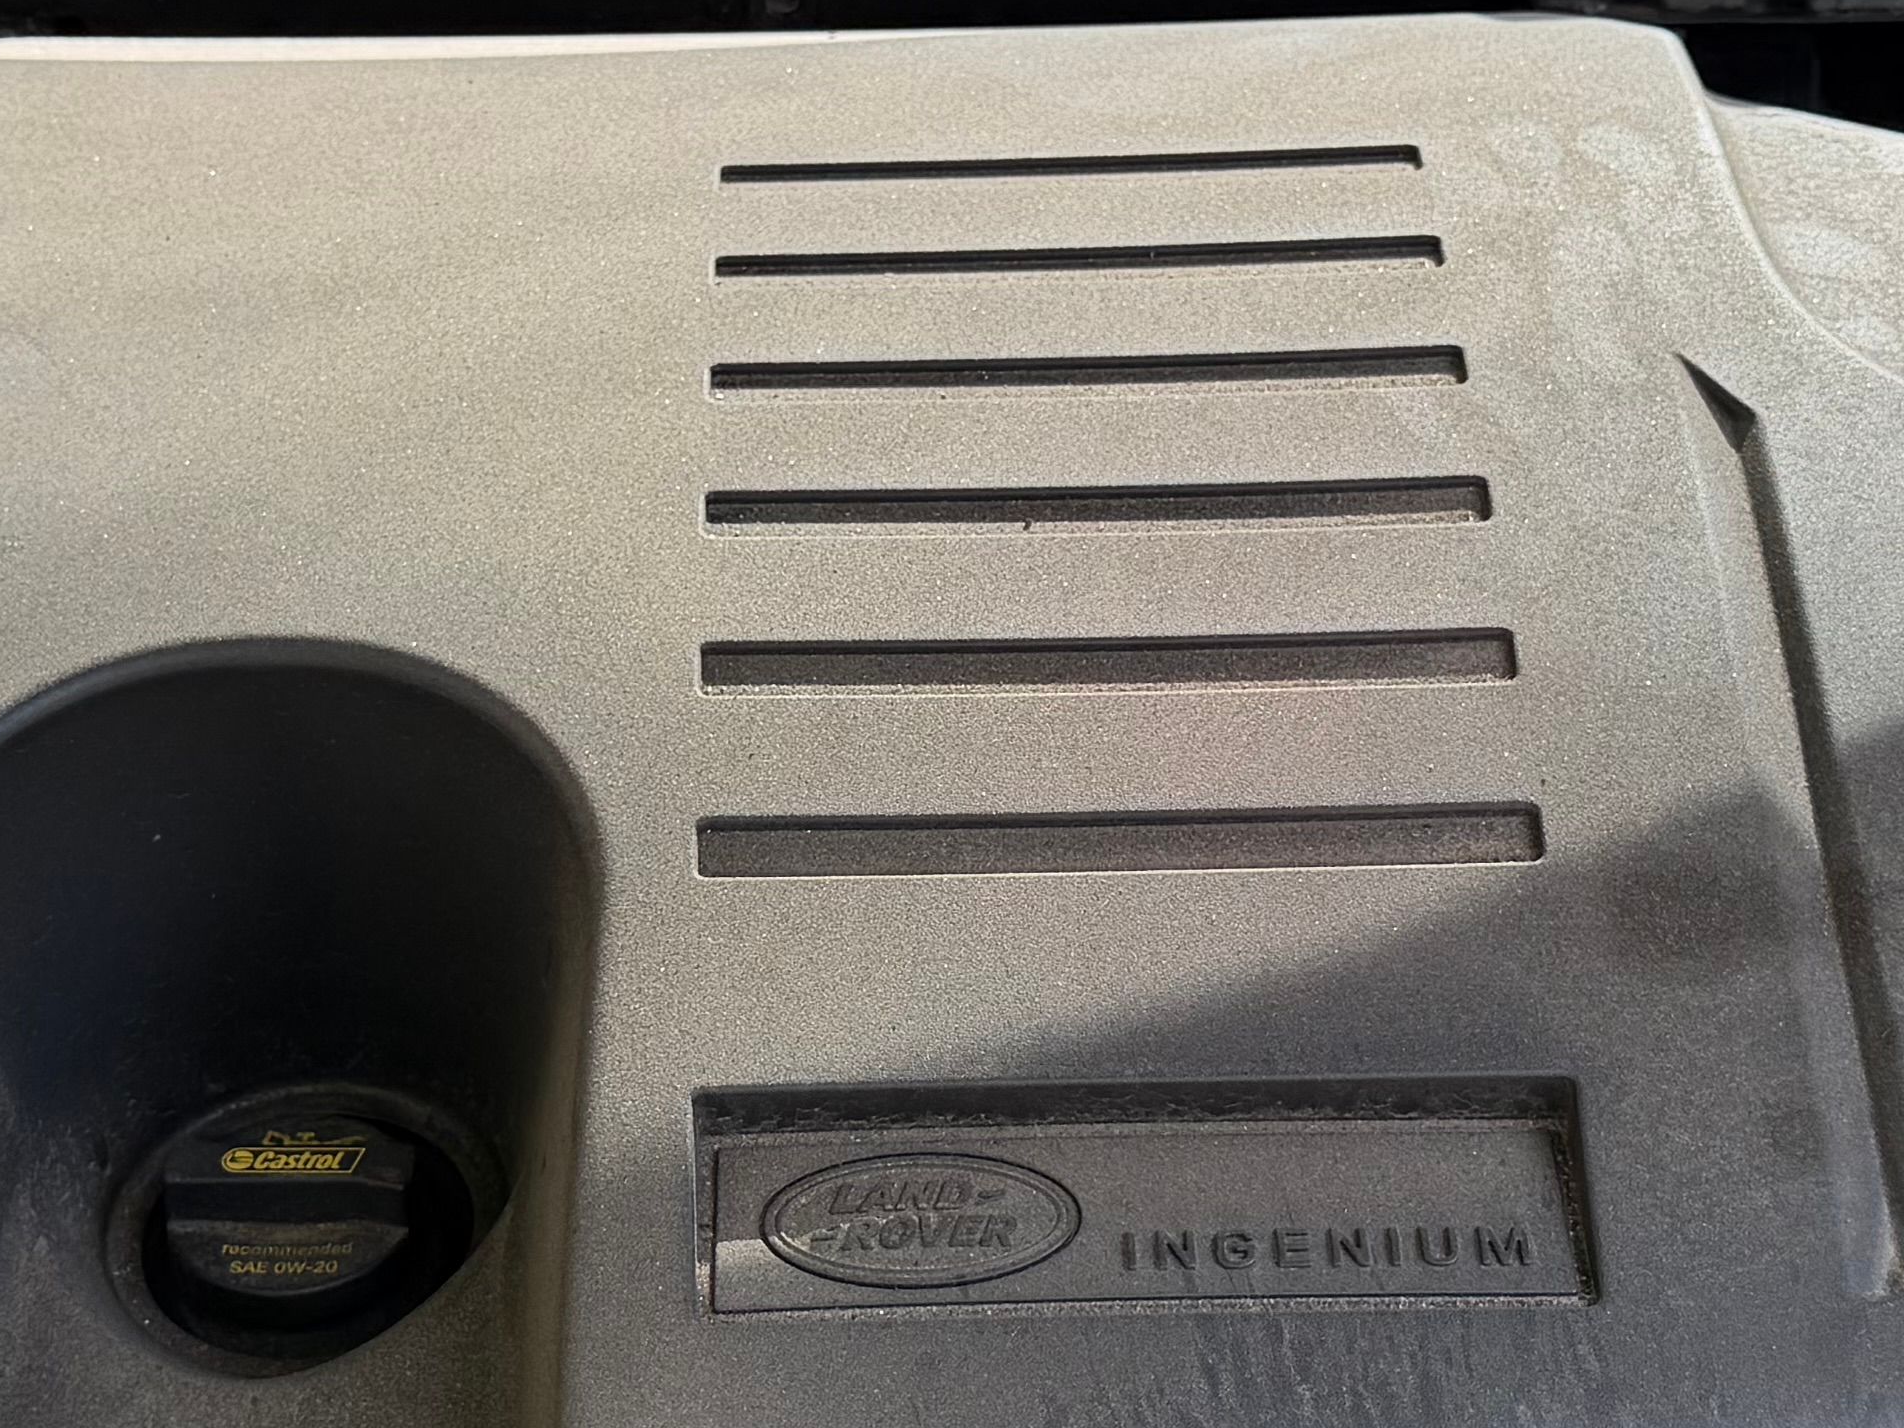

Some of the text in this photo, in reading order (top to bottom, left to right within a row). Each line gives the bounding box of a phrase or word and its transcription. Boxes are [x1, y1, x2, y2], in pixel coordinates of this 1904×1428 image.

[253, 1150, 344, 1170] Castrol
[1124, 1225, 1536, 1272] INGENIUM
[229, 1260, 338, 1274] SAE 0W-20
